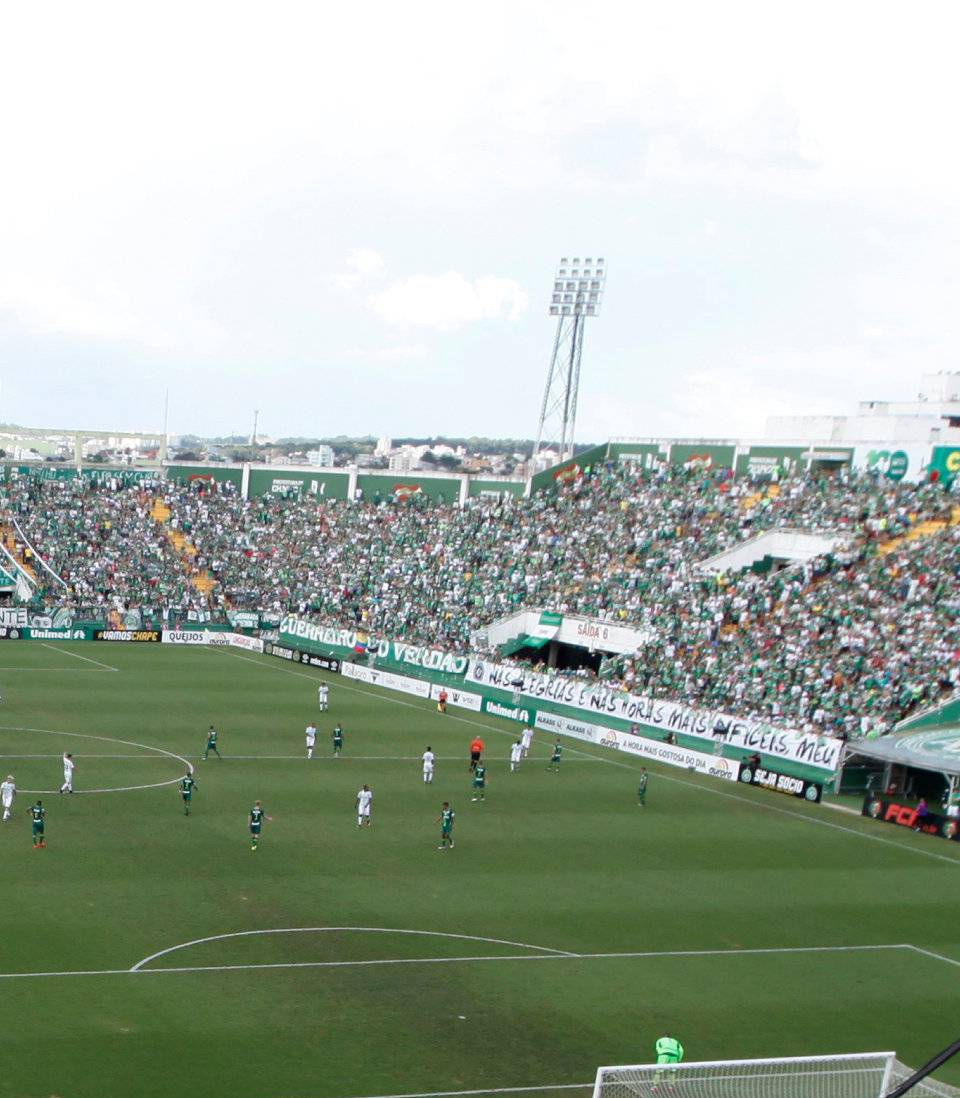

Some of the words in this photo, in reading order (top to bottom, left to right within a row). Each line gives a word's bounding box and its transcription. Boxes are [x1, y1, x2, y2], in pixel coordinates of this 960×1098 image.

[30, 629, 72, 640] Unimed
[97, 630, 159, 641] #VAMOSCHAPE
[169, 632, 204, 643] QUEIJOS
[486, 701, 518, 721] Unimed
[667, 709, 706, 733] MAIS
[796, 738, 836, 765] MEU
[644, 744, 658, 756] MAIS
[658, 748, 685, 763] GOSTOSA
